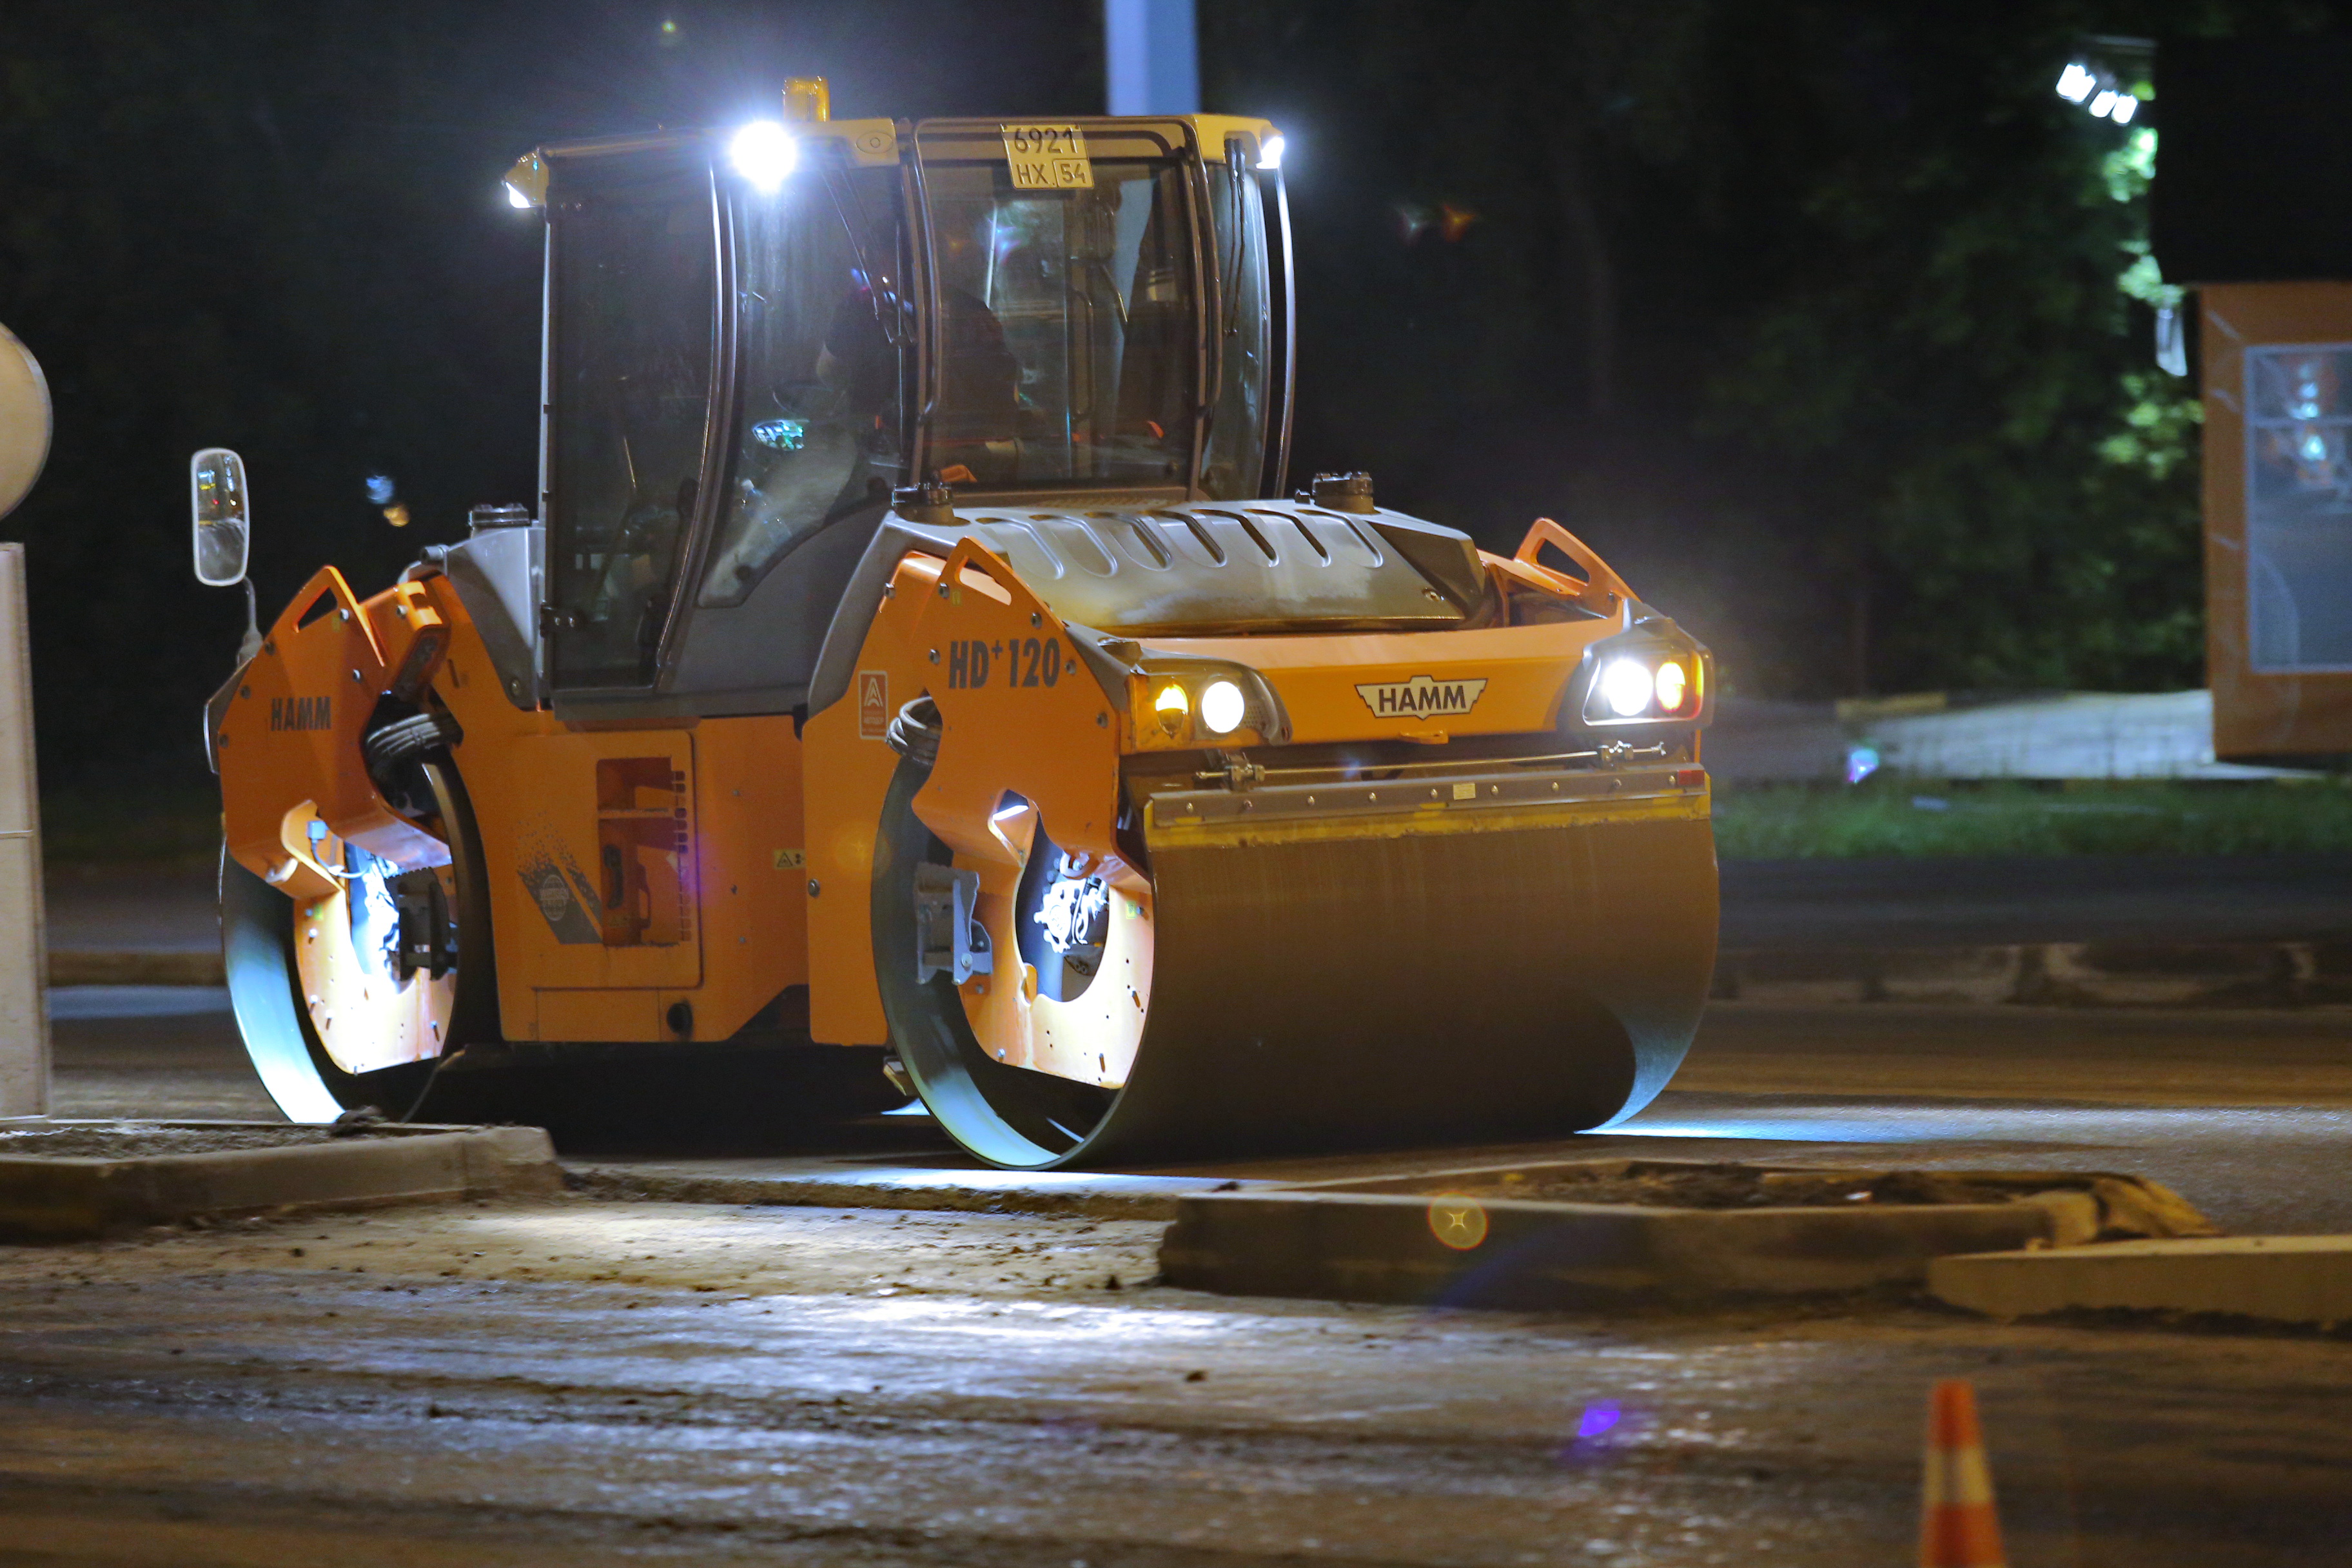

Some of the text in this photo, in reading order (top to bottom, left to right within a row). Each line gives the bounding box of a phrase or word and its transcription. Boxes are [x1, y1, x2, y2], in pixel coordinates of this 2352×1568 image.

[1014, 127, 1078, 153] 6921
[1061, 163, 1086, 183] 54
[1008, 638, 1061, 687] 120
[1378, 685, 1466, 712] HAMM
[271, 696, 331, 731] HAMM
